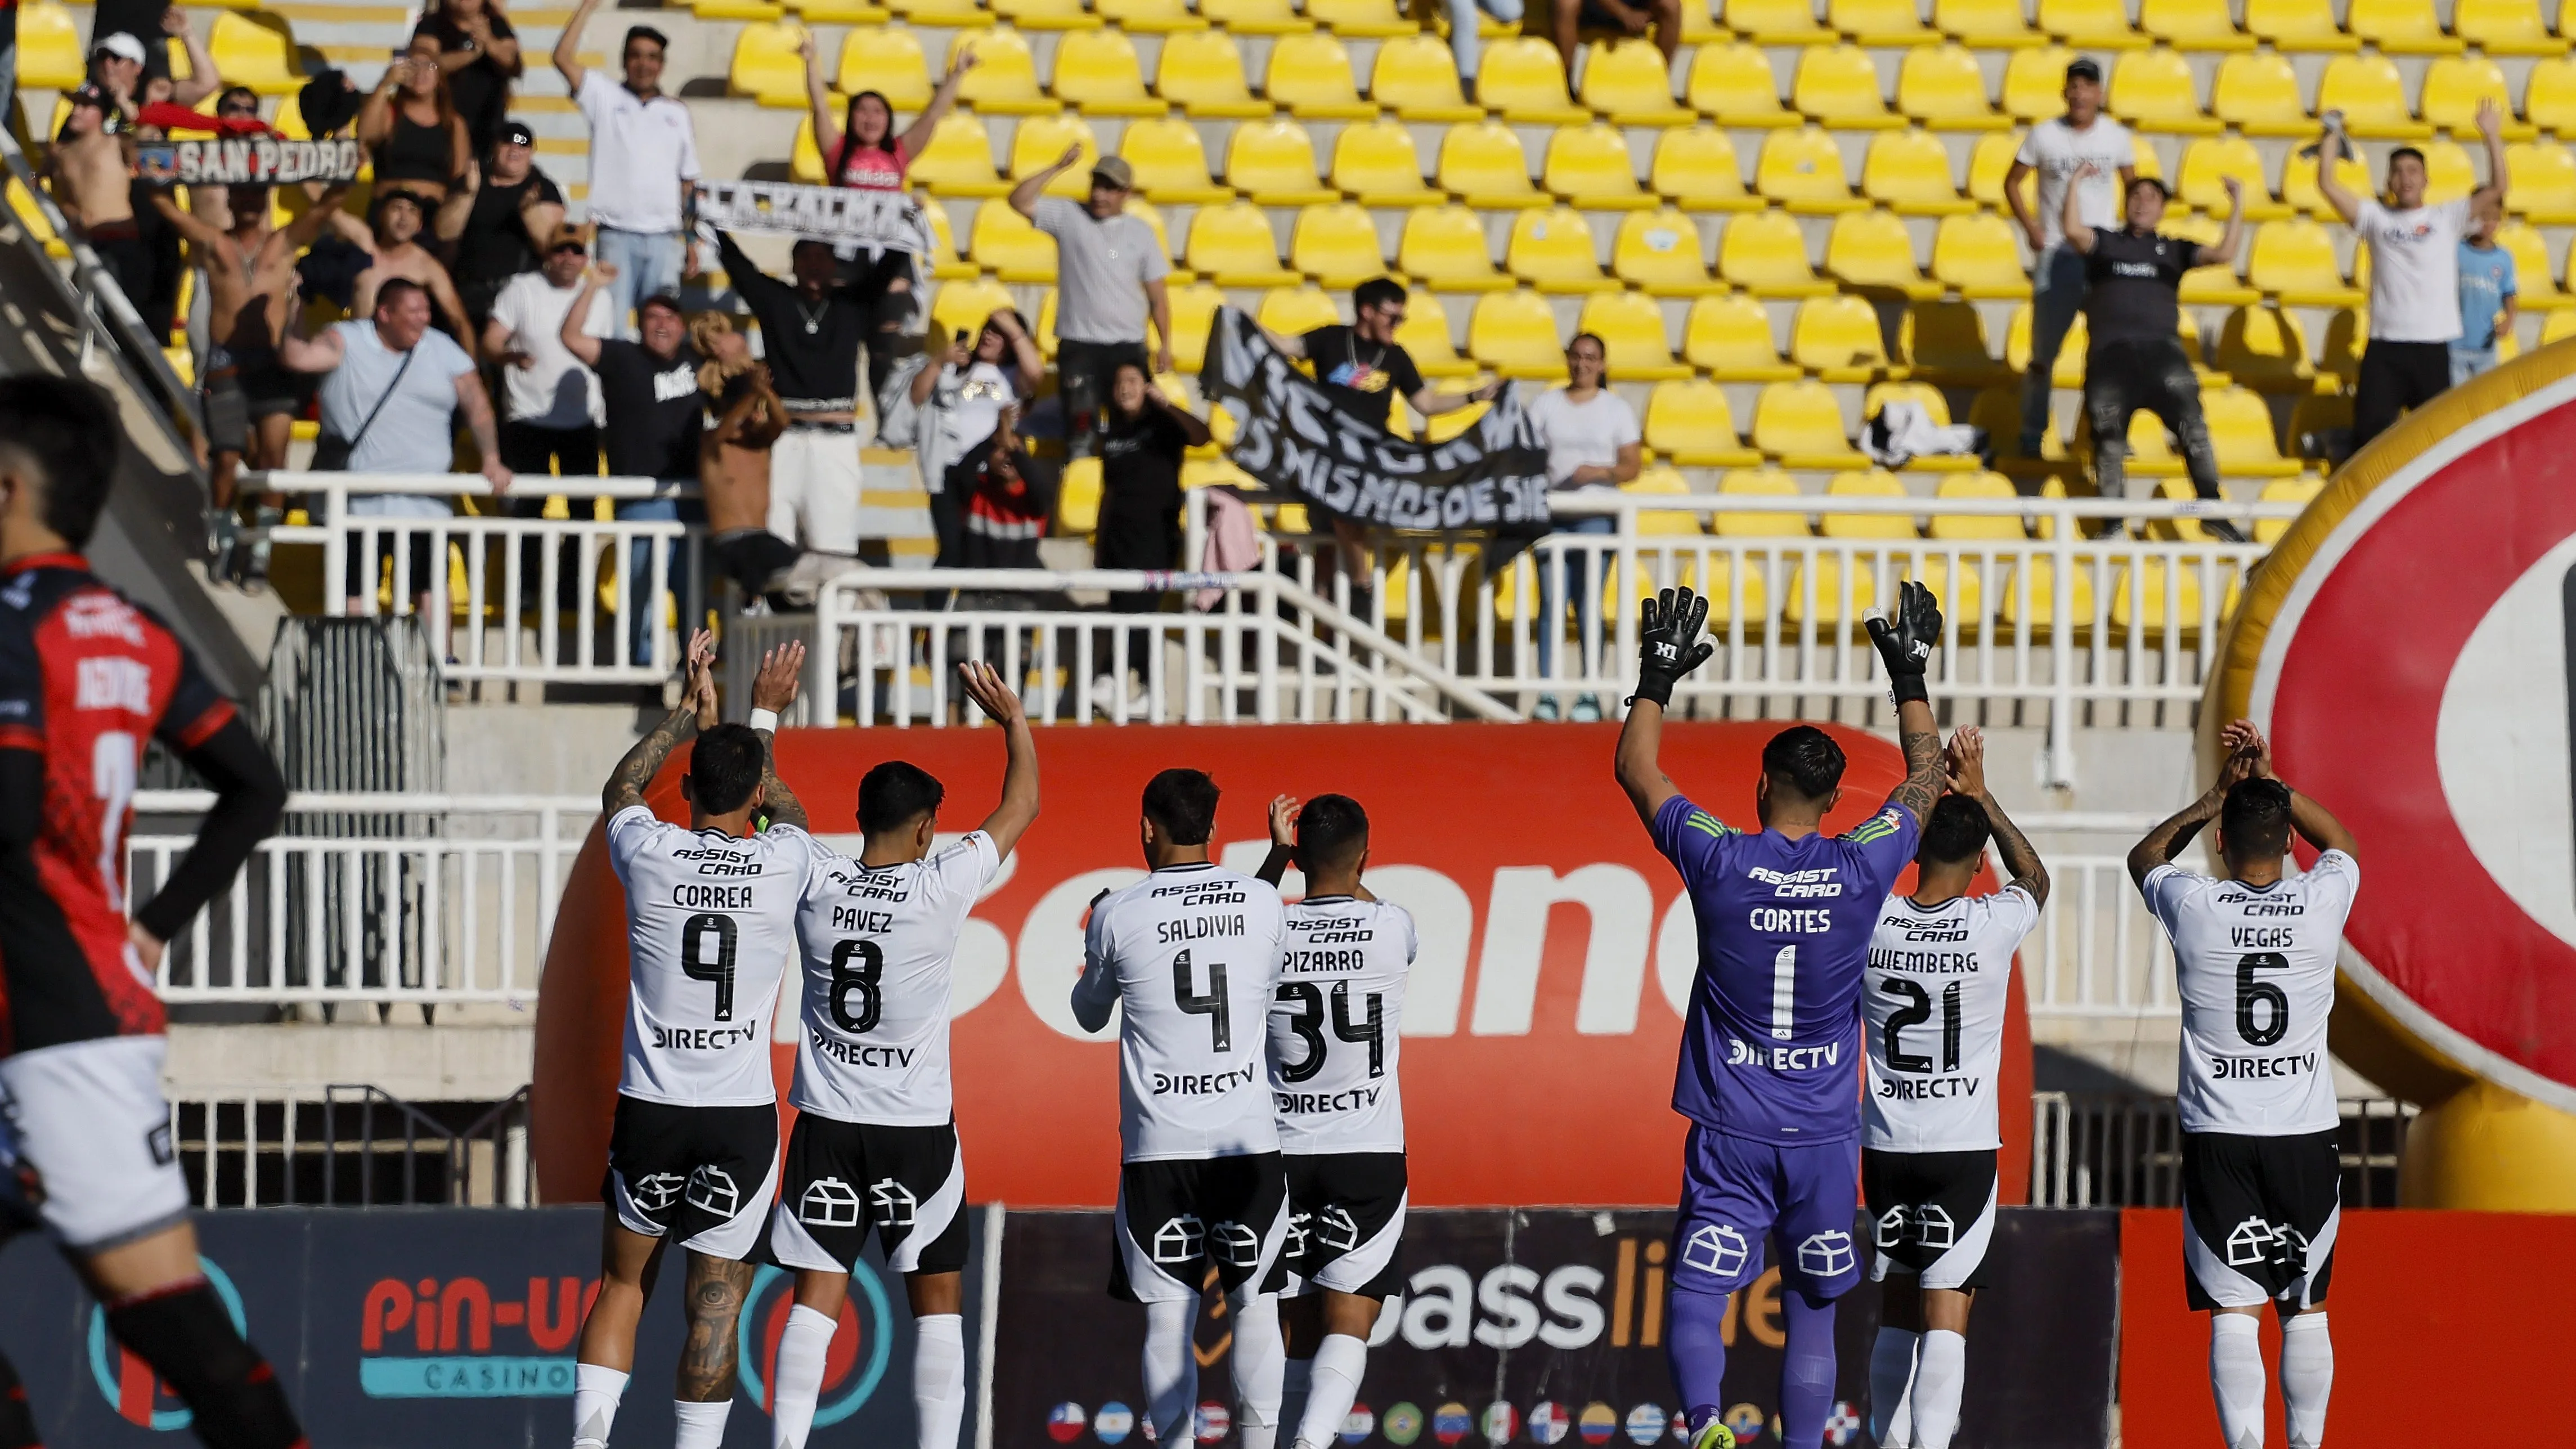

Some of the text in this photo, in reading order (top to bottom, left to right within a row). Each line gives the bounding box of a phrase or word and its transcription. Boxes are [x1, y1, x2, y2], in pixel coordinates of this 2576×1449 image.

[178, 139, 358, 183] SAN PEDRO
[672, 848, 755, 864] ASSIST
[698, 862, 762, 876] CARD
[1748, 867, 1838, 885] ASSIST
[673, 884, 752, 908] CORREA
[847, 885, 908, 903] CARD
[1151, 881, 1240, 899] ASSIST
[1182, 891, 1246, 907] CARD
[1774, 883, 1842, 898] CARD
[832, 905, 893, 933] PAVEZ
[1750, 908, 1831, 934] CORTES
[2243, 904, 2305, 916] CARD
[1157, 914, 1245, 944] SALDIVIA
[1286, 917, 1366, 931] ASSIST
[1308, 930, 1374, 943] CARD
[1905, 930, 1969, 943] CARD
[2231, 927, 2294, 948] VEGAS
[681, 913, 738, 1022] 9
[1281, 949, 1364, 973] PIZARRO
[1868, 947, 1979, 974] WIEMBERG
[829, 939, 883, 1034] 8
[1771, 945, 1796, 1041] 1
[2236, 952, 2290, 1047] 6
[1173, 948, 1232, 1053] 4
[652, 1020, 756, 1050] DIRECTV
[1275, 980, 1385, 1083] 34
[1879, 977, 1962, 1074] 21
[812, 1026, 915, 1067] DIRECTV
[1727, 1039, 1839, 1071] DIRECTV
[2211, 1052, 2315, 1079] DIRECTV
[1154, 1063, 1254, 1096] DIRECTV
[1877, 1077, 1980, 1100] DIRECTV
[1276, 1087, 1381, 1114] DIRECTV
[424, 1363, 569, 1390] CASINO
